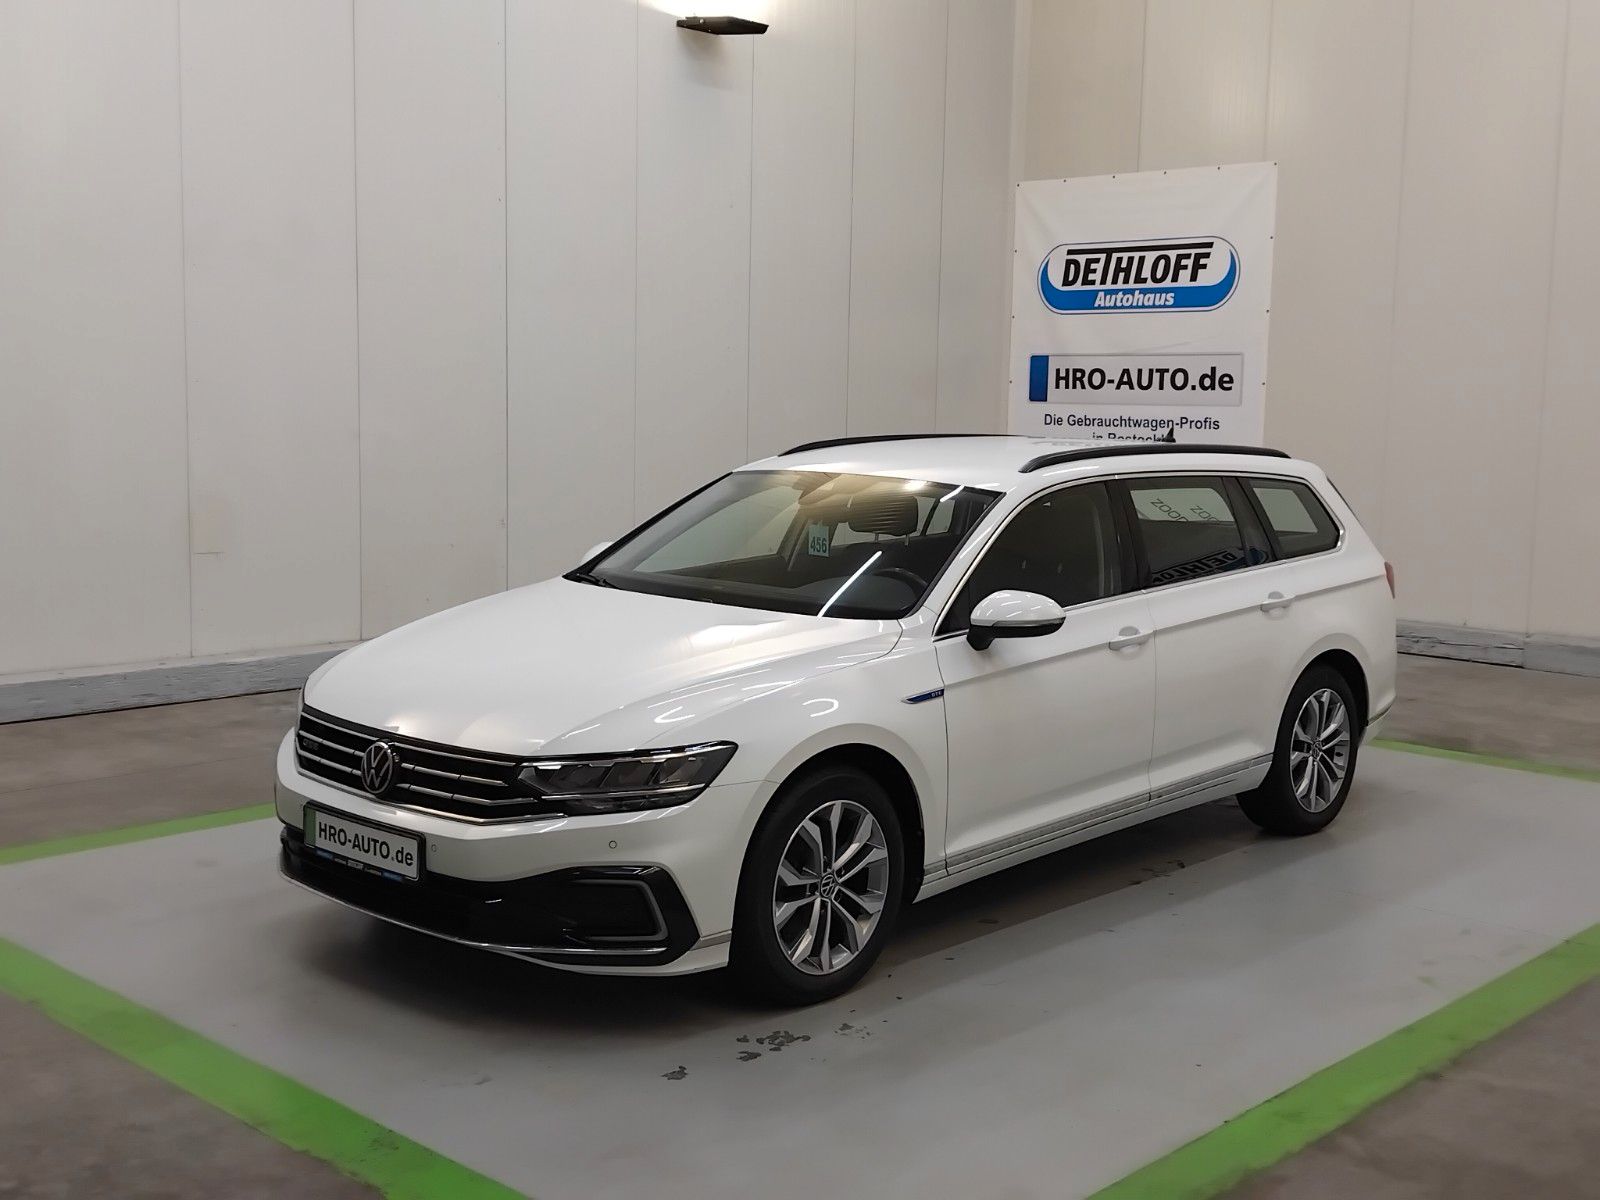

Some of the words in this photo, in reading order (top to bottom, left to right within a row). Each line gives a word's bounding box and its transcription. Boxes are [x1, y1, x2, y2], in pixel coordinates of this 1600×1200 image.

[1061, 241, 1214, 287] DETHLOFF
[1094, 290, 1175, 308] Autohaus
[1054, 366, 1234, 391] HRO-AUTO.de
[1043, 413, 1064, 426] Die
[1066, 414, 1221, 431] Gebrauchtwagen-Profis
[810, 536, 828, 553] 456
[318, 821, 414, 867] HRO-AUTO.de
